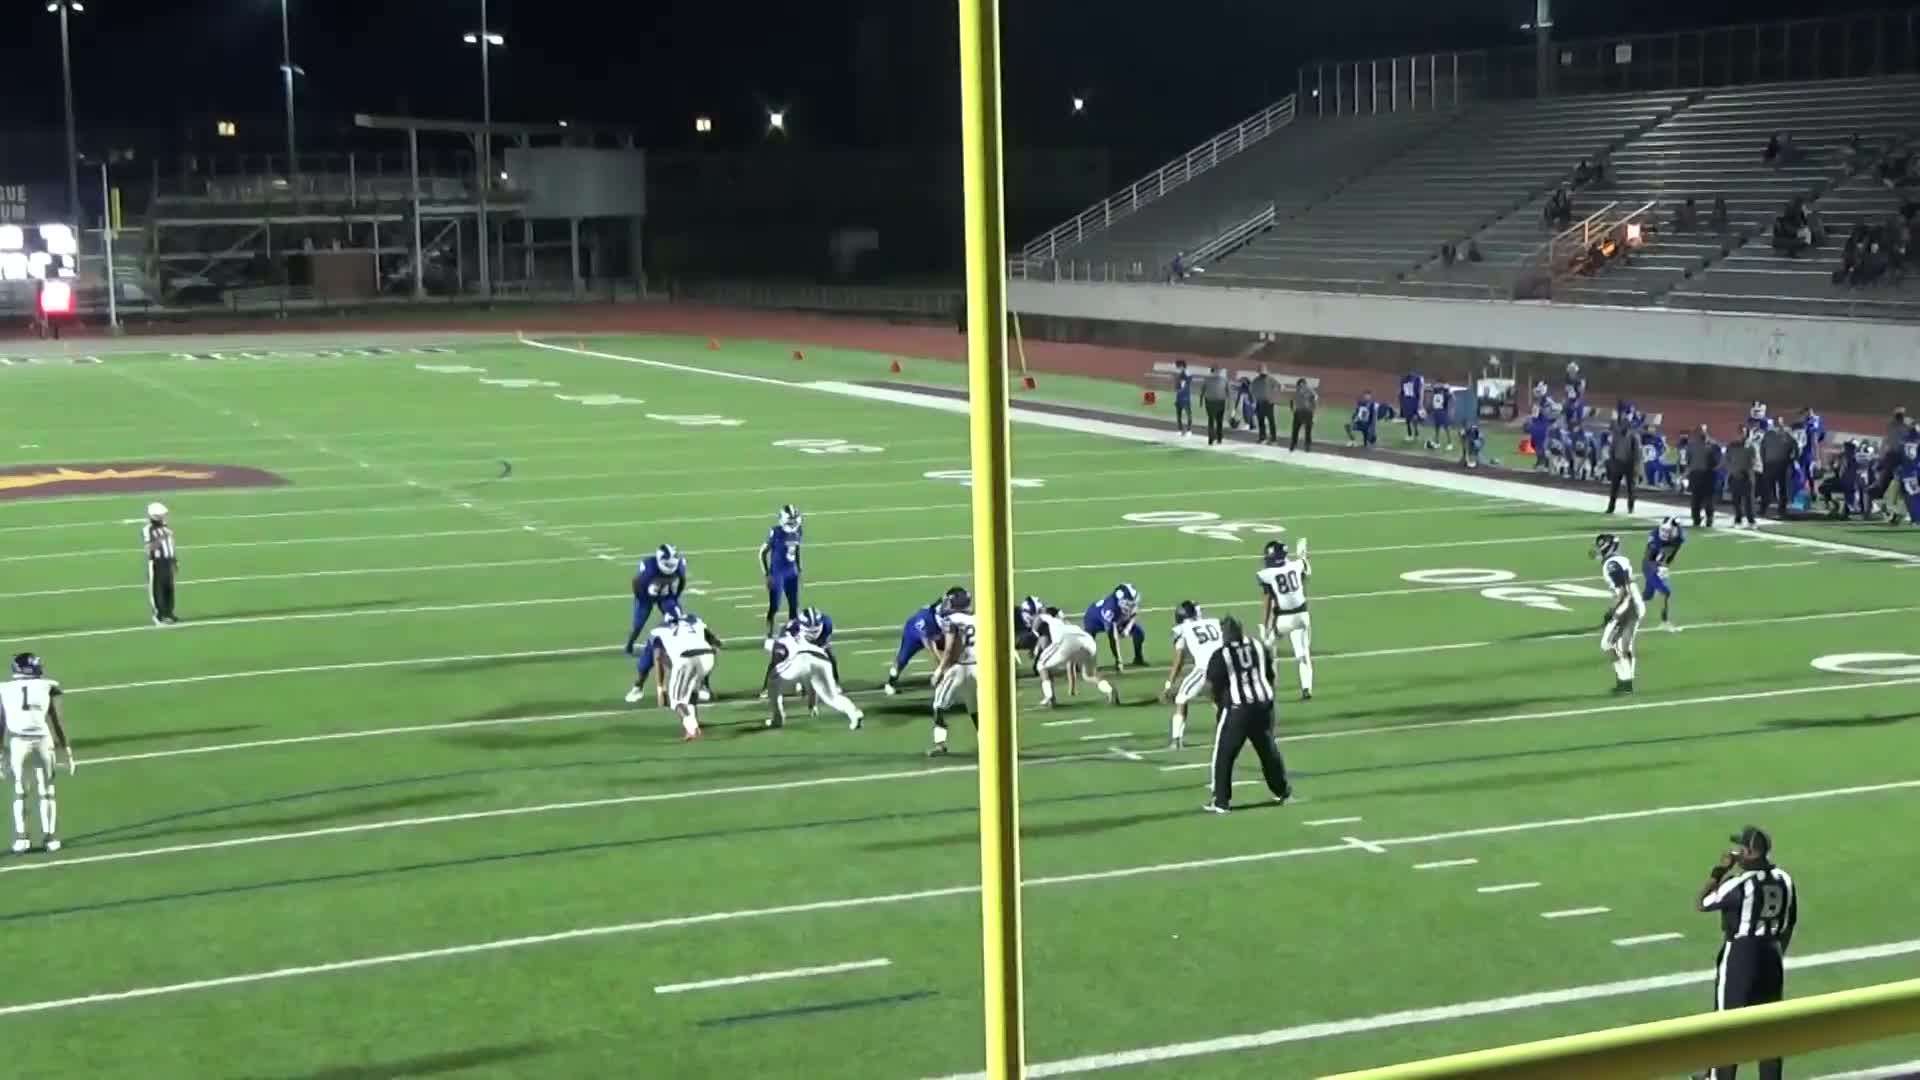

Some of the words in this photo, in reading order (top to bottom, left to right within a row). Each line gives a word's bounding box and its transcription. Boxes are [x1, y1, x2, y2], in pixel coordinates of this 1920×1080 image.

[1275, 569, 1300, 594] 80
[1192, 622, 1220, 645] 50
[1236, 646, 1254, 669] U
[21, 685, 32, 711] 1
[1760, 884, 1784, 919] B
